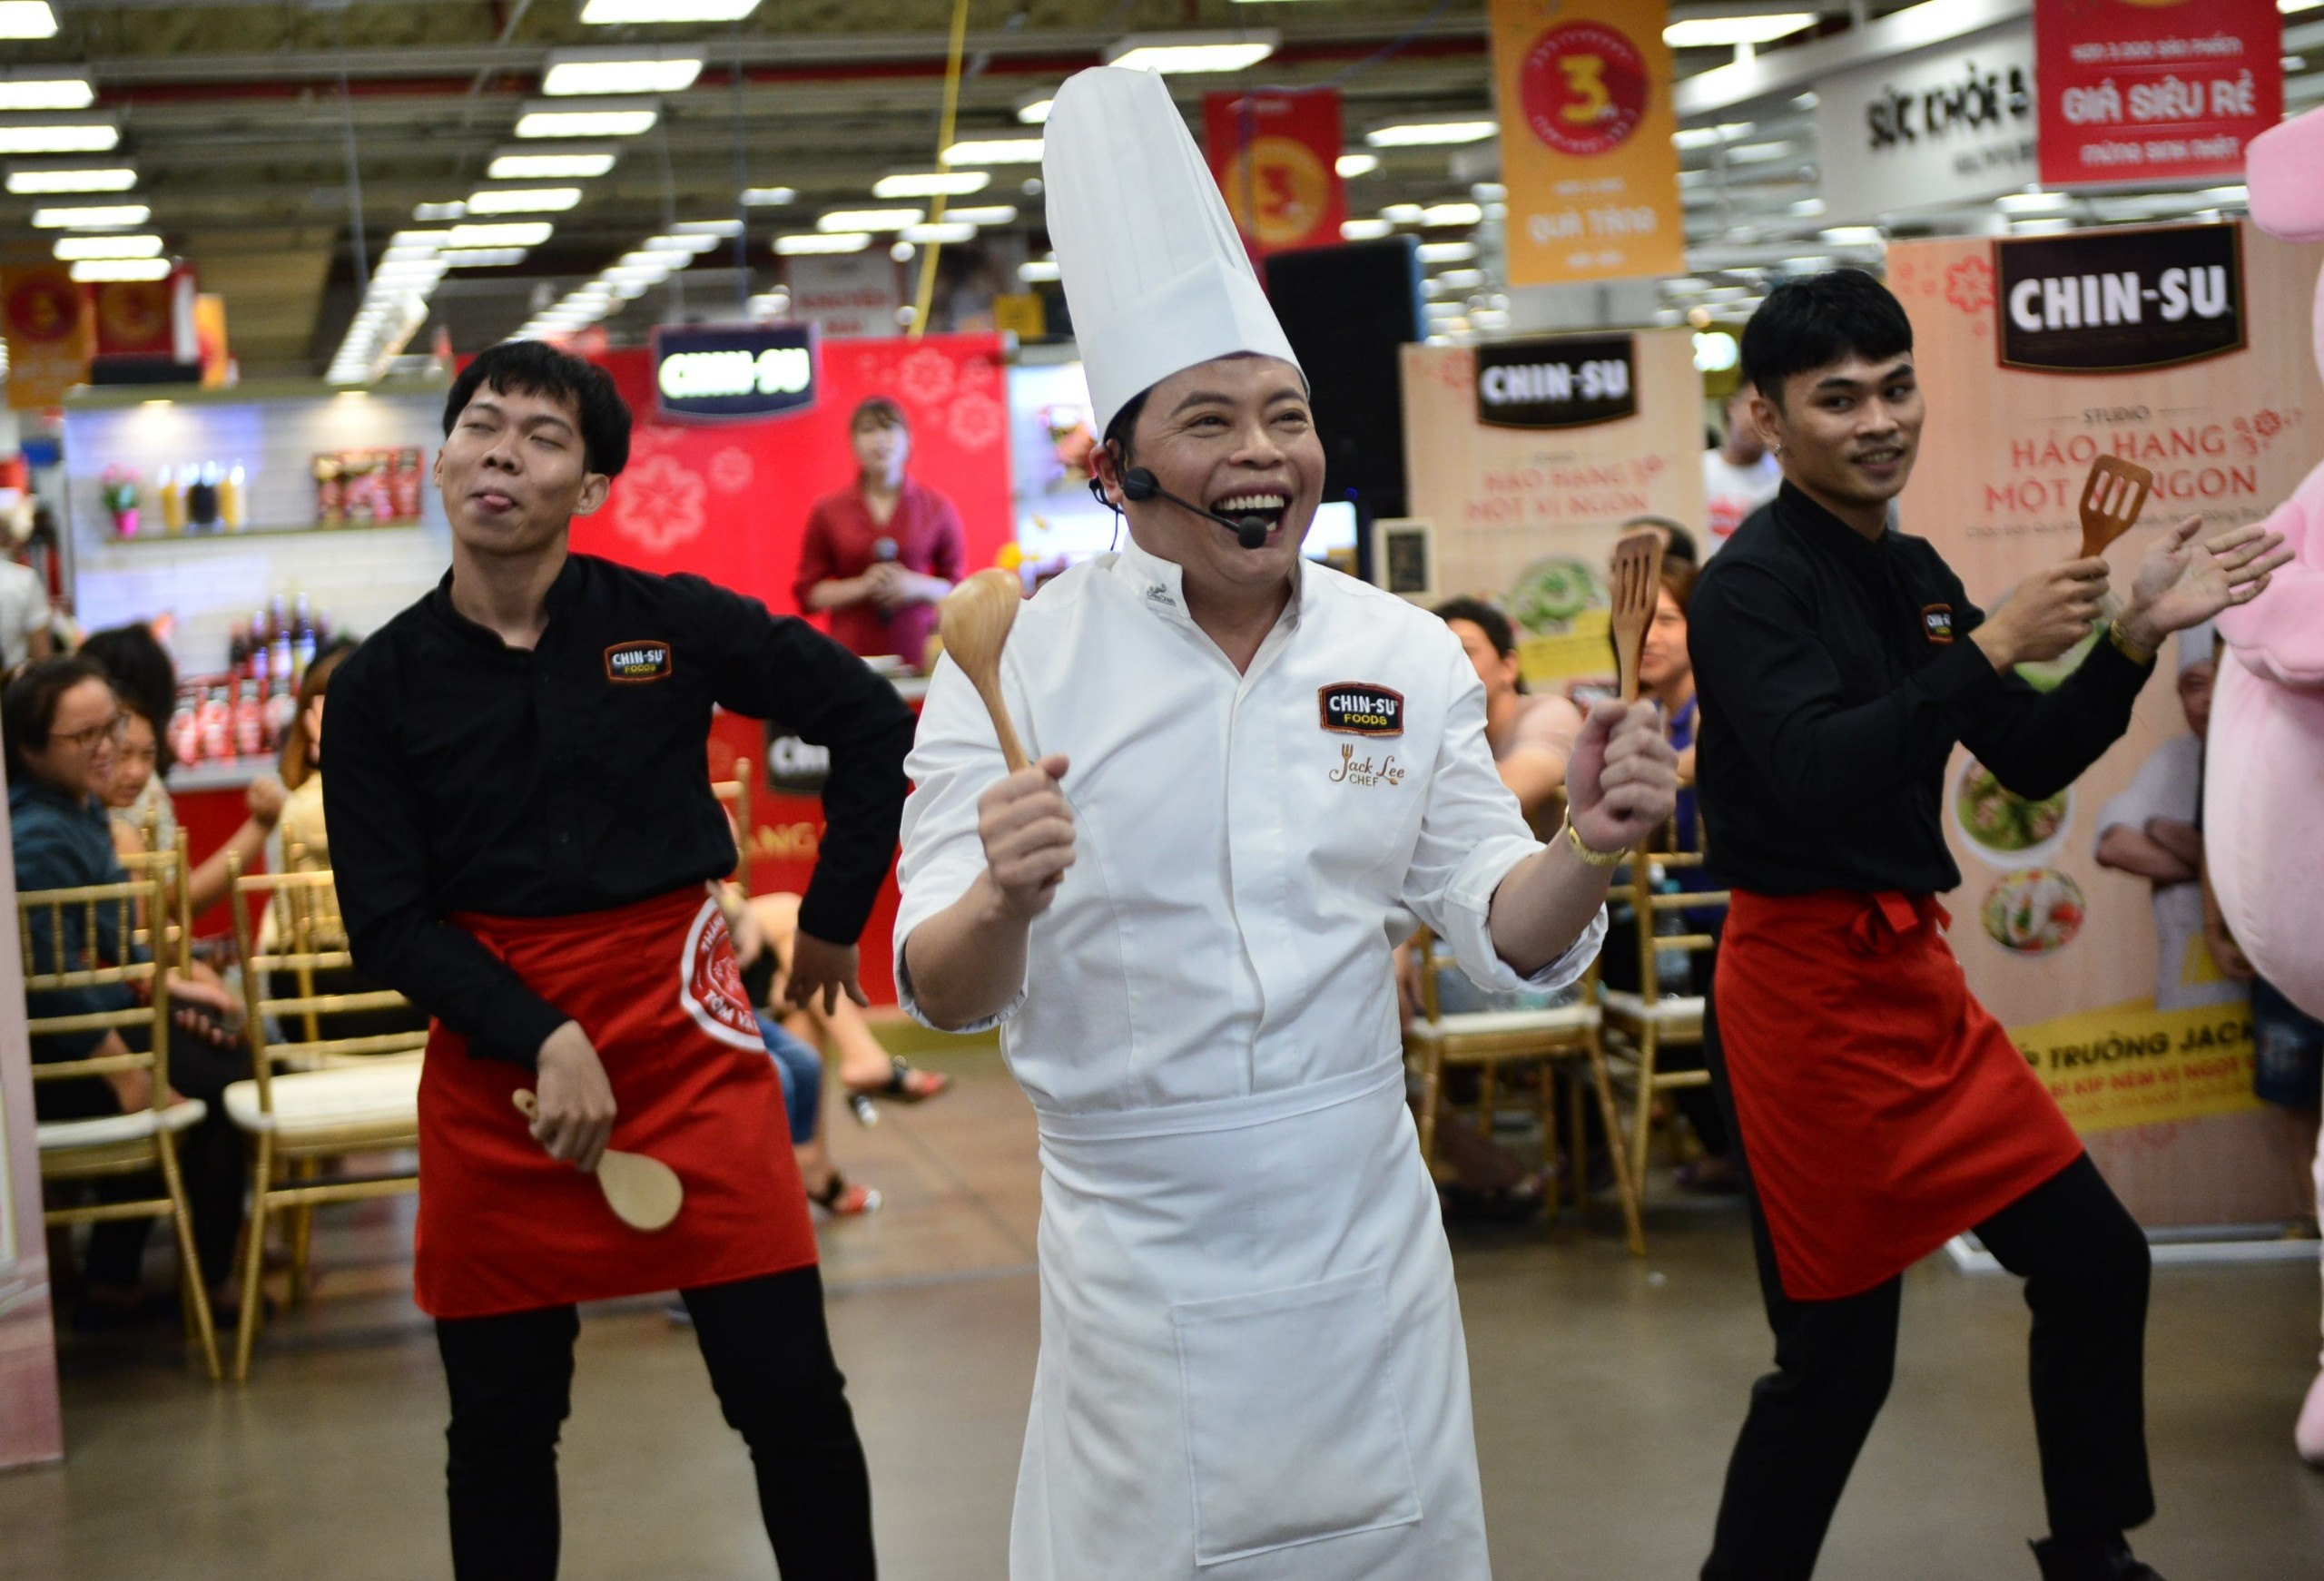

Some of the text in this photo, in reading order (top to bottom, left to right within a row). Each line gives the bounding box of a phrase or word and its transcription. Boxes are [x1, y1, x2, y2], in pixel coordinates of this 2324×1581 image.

[1559, 54, 1610, 123] 3
[2062, 78, 2122, 123] GIÁ
[2129, 74, 2204, 121] SIÊU
[2009, 265, 2226, 332] CHIN-SU
[1482, 359, 1629, 405] CHIN-SU
[612, 649, 664, 666] CHIN-SU
[1329, 694, 1396, 715] CHIN-SU
[1344, 713, 1387, 725] FOODS
[1328, 742, 1404, 781] Jack Lee
[1349, 773, 1379, 787] CHEF
